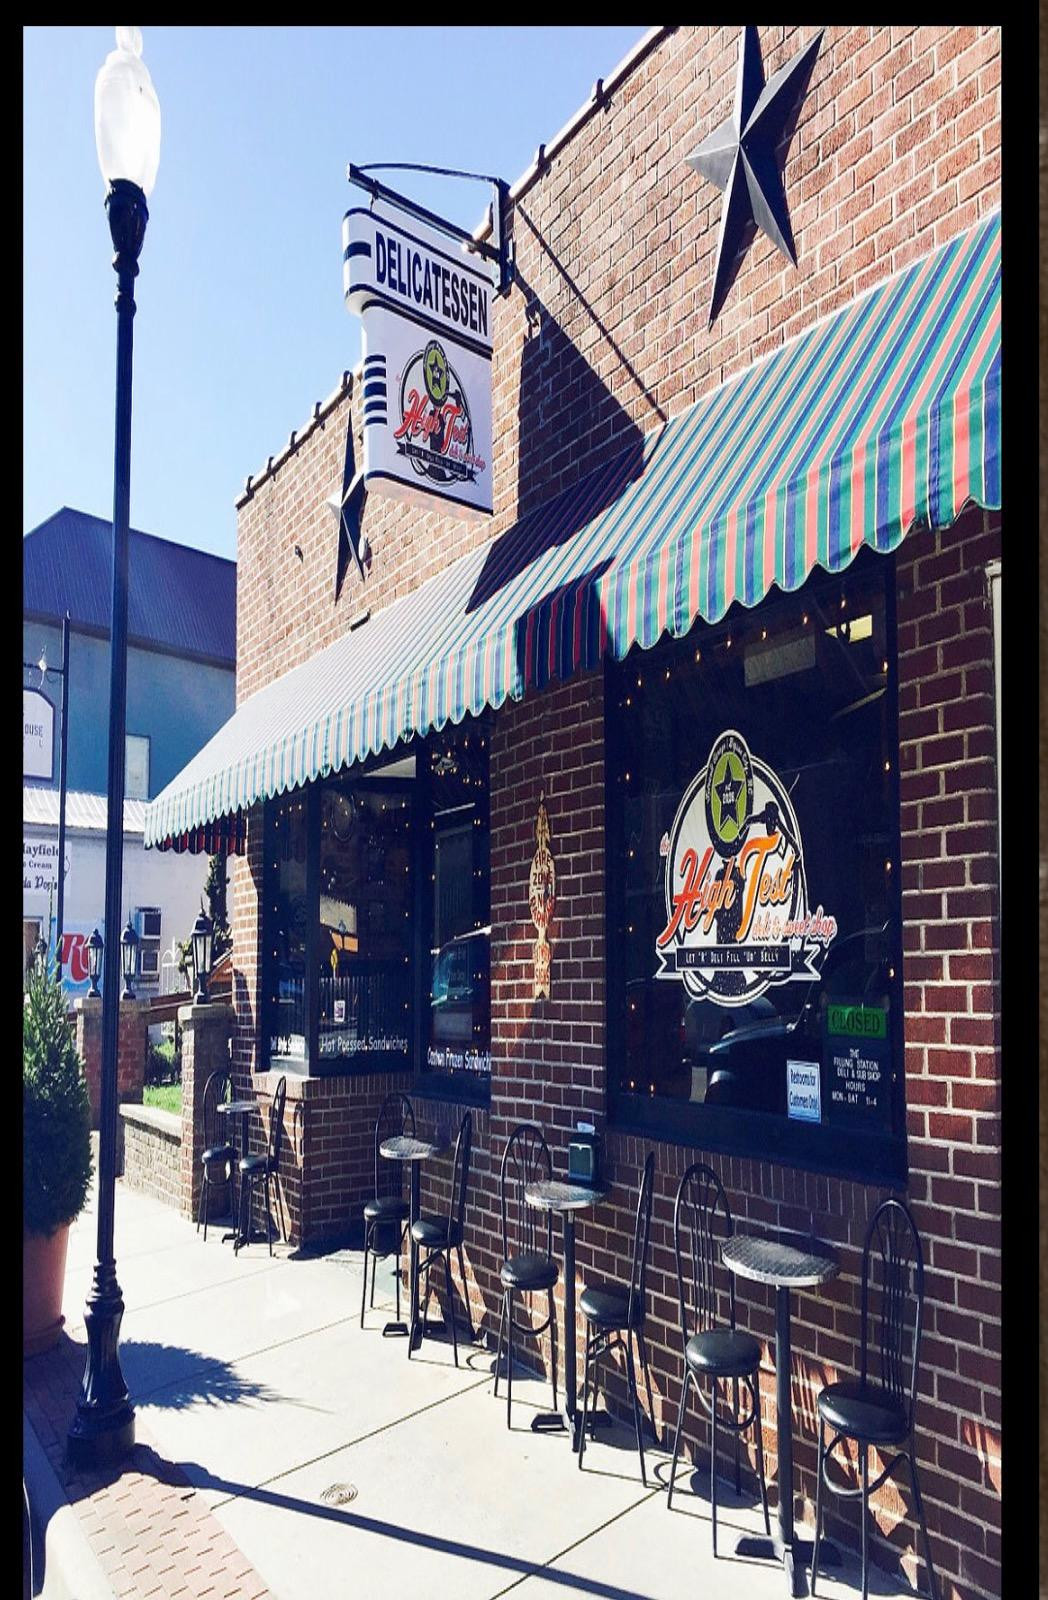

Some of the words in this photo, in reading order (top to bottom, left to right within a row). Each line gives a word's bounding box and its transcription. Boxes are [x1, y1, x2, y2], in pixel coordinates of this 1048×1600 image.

[376, 231, 487, 336] DELICATESSEN
[394, 388, 442, 443] High
[29, 860, 52, 869] Cream
[657, 847, 736, 949] High
[736, 832, 796, 943] Test
[831, 1009, 880, 1033] CLOSED
[320, 1036, 335, 1052] Hot
[368, 1035, 408, 1051] Sandwiches
[837, 1067, 849, 1078] DELI
[867, 1071, 881, 1081] SHOP
[857, 1060, 879, 1071] STATION
[846, 1081, 866, 1092] HOURS
